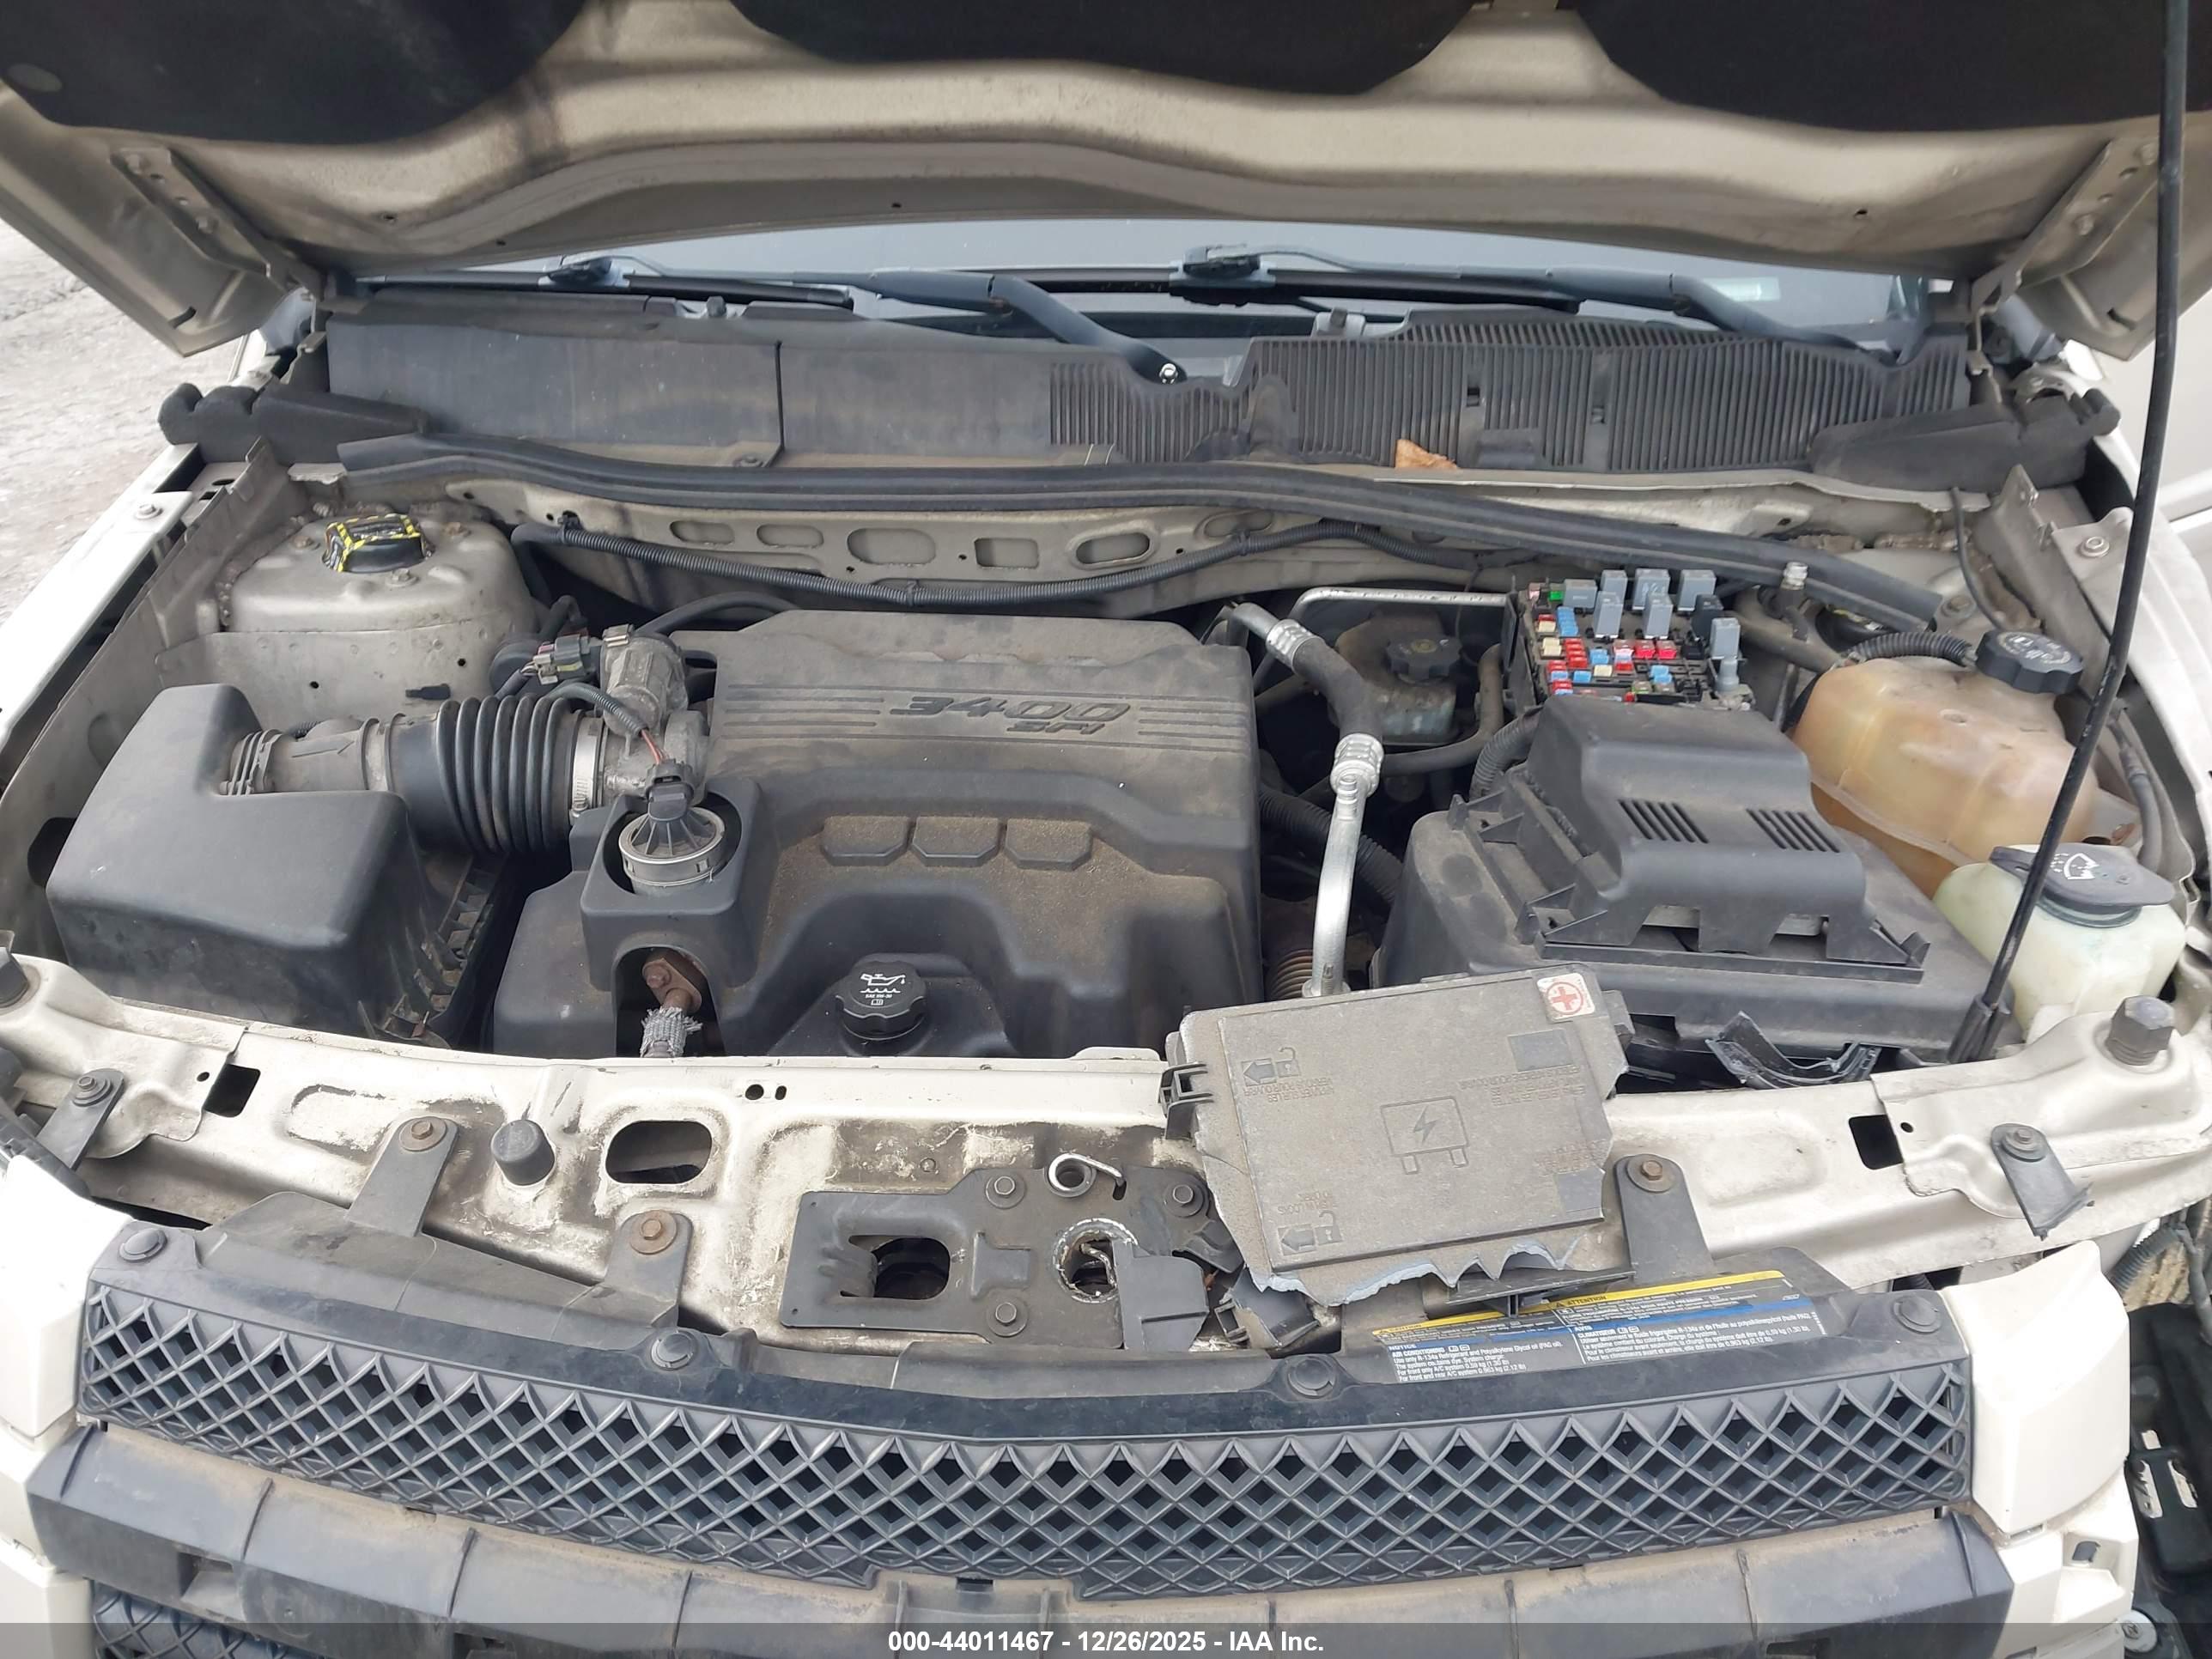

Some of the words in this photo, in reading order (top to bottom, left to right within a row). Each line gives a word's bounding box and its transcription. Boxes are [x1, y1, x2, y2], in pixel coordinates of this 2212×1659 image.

[890, 696, 1131, 722] 3400
[1567, 1295, 1607, 1305] ATTENTION
[1402, 1347, 1445, 1356] CONDITIONING
